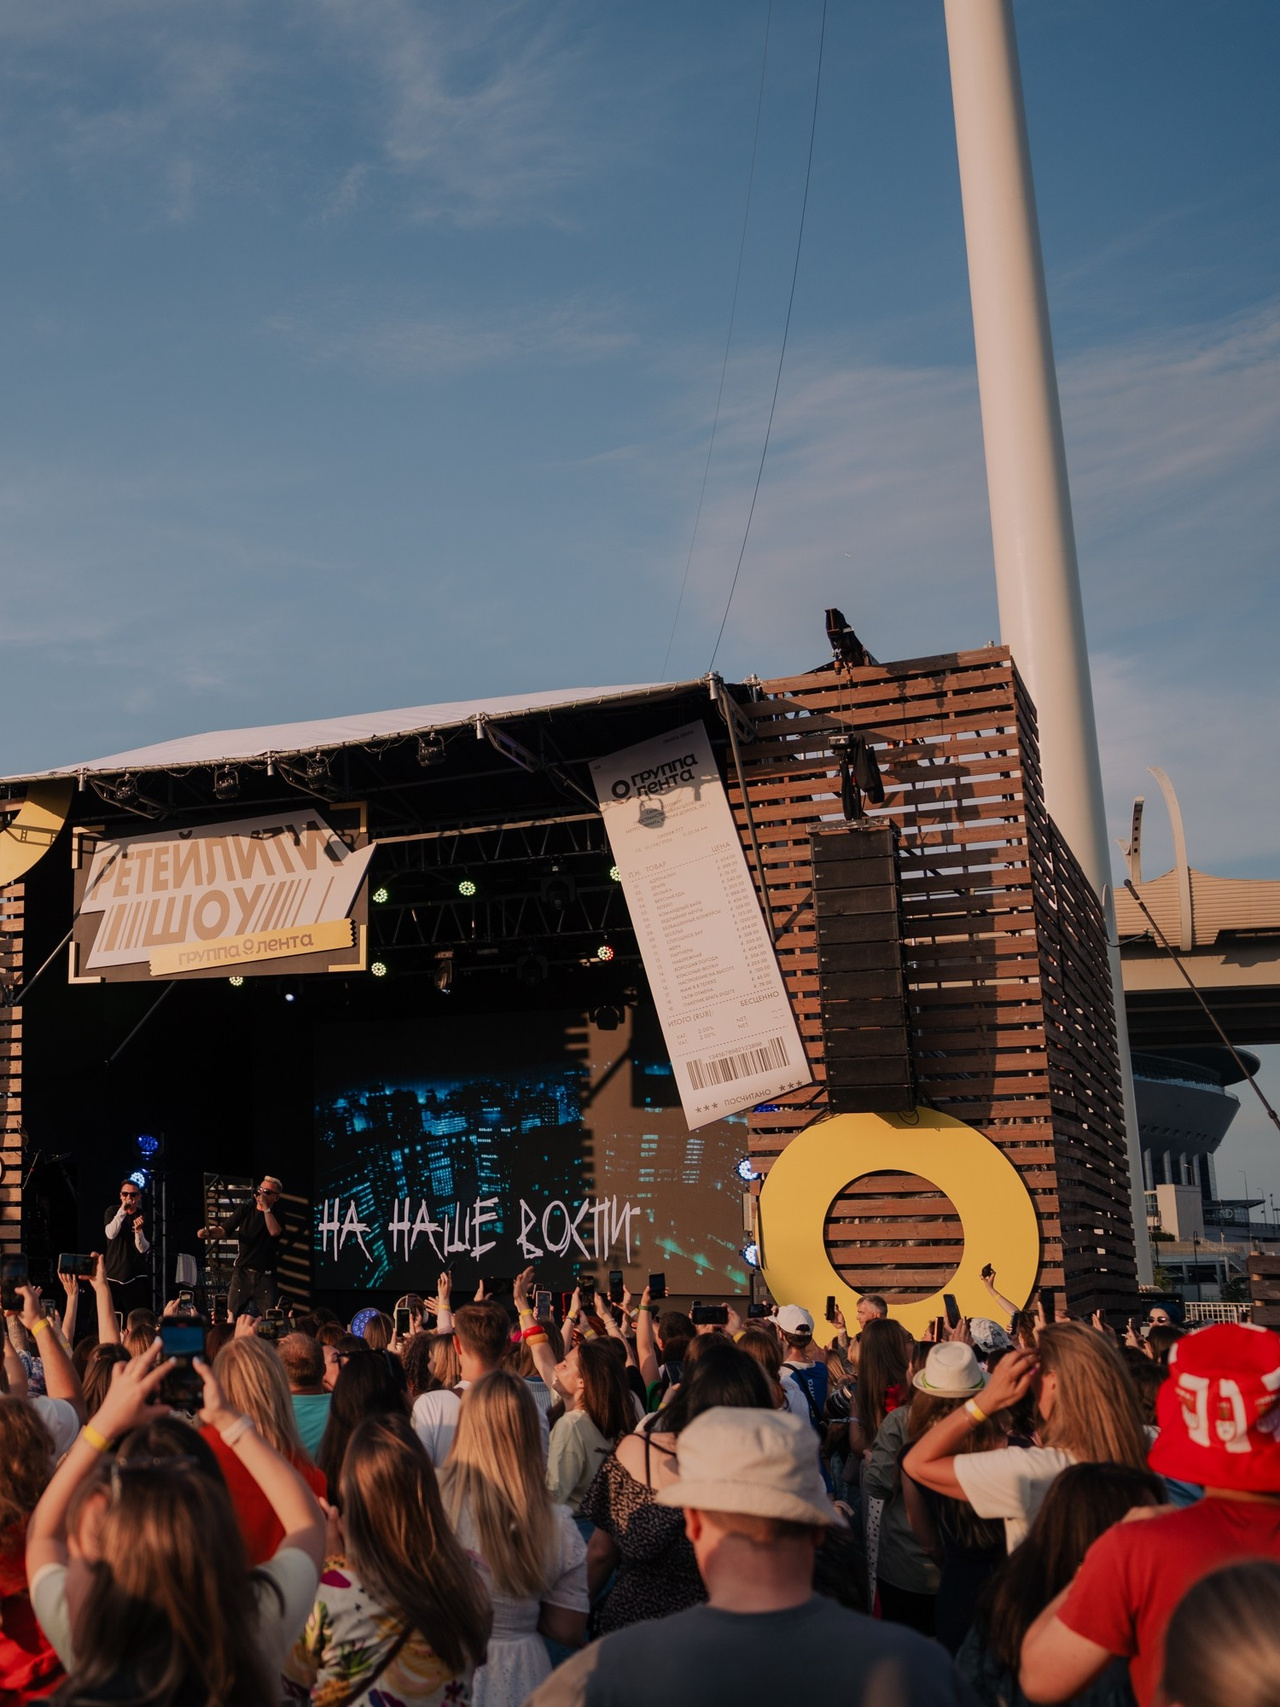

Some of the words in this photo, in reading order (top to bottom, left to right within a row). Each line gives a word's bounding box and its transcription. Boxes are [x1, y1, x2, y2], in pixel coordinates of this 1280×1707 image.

[631, 753, 698, 787] группа
[89, 820, 345, 901] РЕТЕЙЛИТИ
[645, 861, 667, 872] ТОВАР
[711, 842, 731, 852] ЦЕНА
[142, 883, 266, 947] ШОУ
[178, 944, 242, 966] группа
[256, 932, 314, 955] лента
[668, 1016, 692, 1027] ИТОГО
[740, 992, 780, 1007] БЕСЦЕННО
[724, 1089, 772, 1106] ПОСЧИТАНО
[318, 1197, 374, 1263] НА
[388, 1196, 499, 1263] НАШЕ
